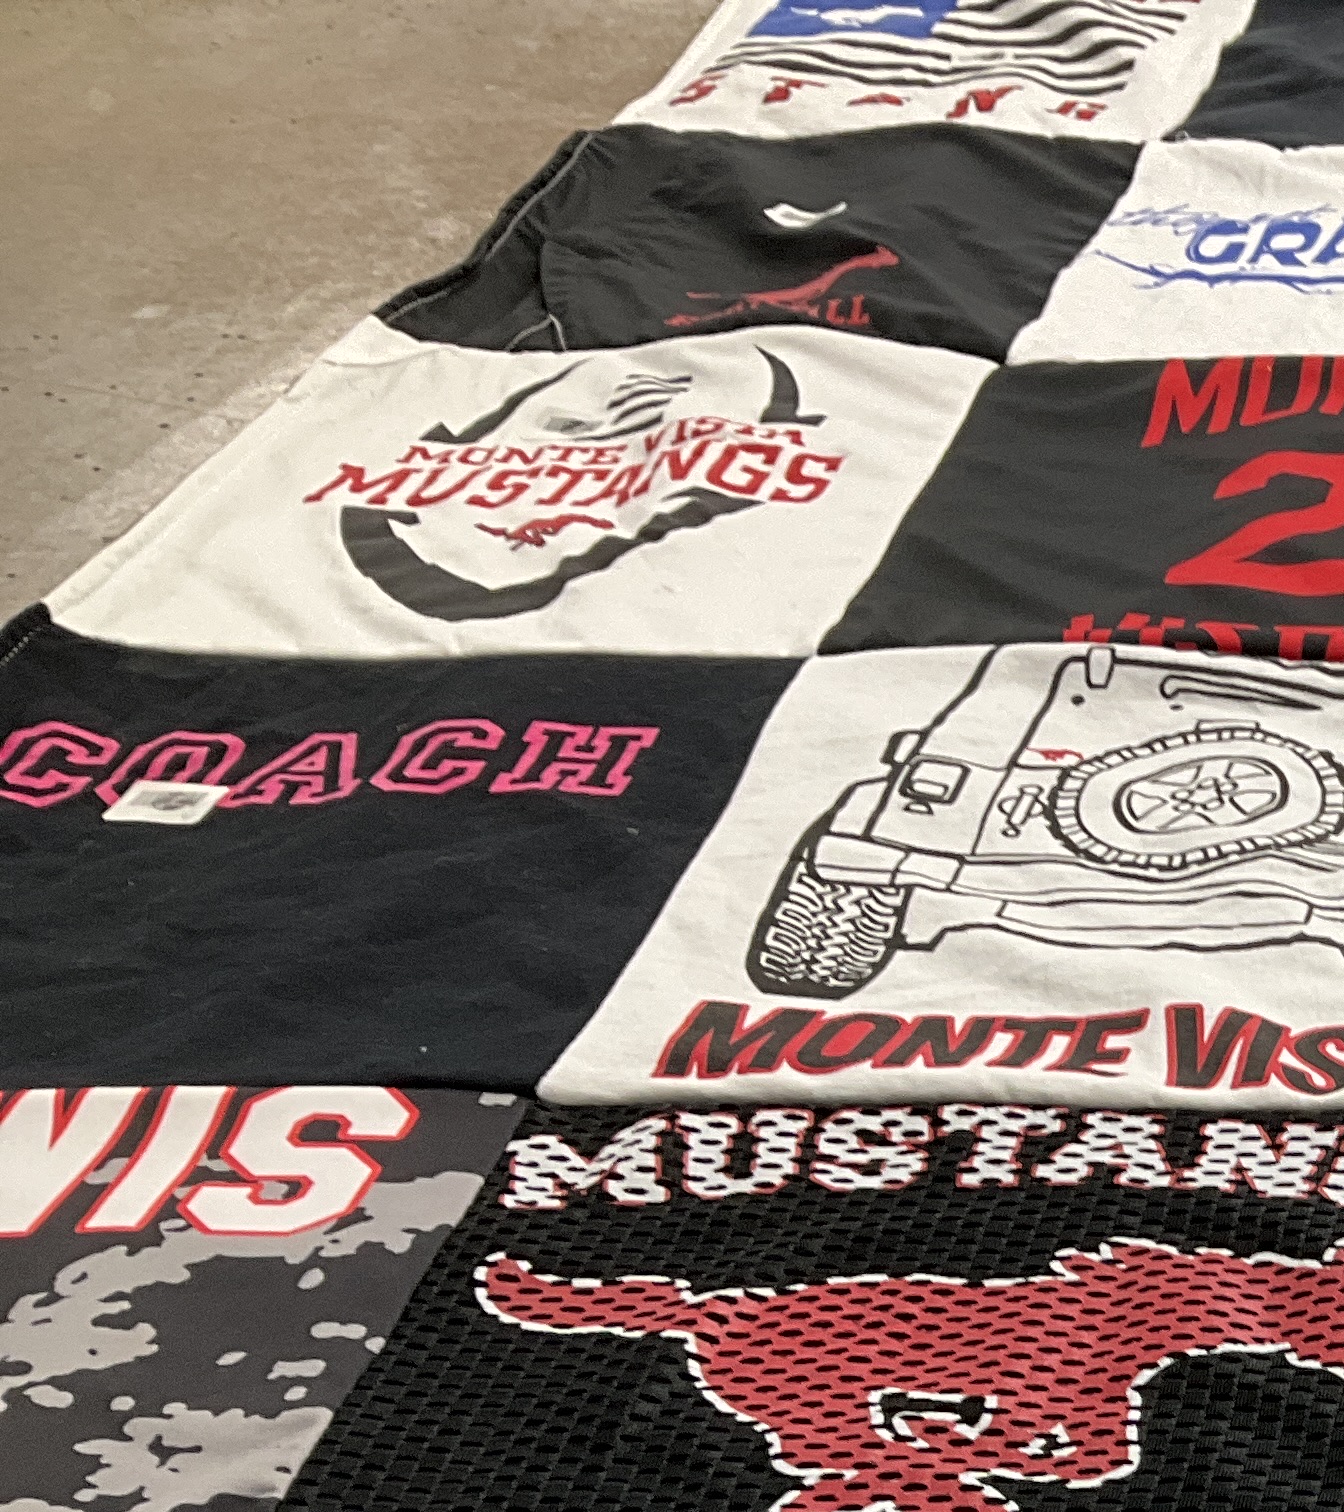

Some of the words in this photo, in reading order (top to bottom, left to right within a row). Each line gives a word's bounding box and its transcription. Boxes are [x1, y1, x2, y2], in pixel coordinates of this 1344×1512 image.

[302, 440, 851, 509] MUSTANGS
[394, 444, 630, 467] MONTE
[644, 415, 807, 454] VISTA
[0, 718, 661, 809] COACH
[650, 1000, 1152, 1080] MONTE
